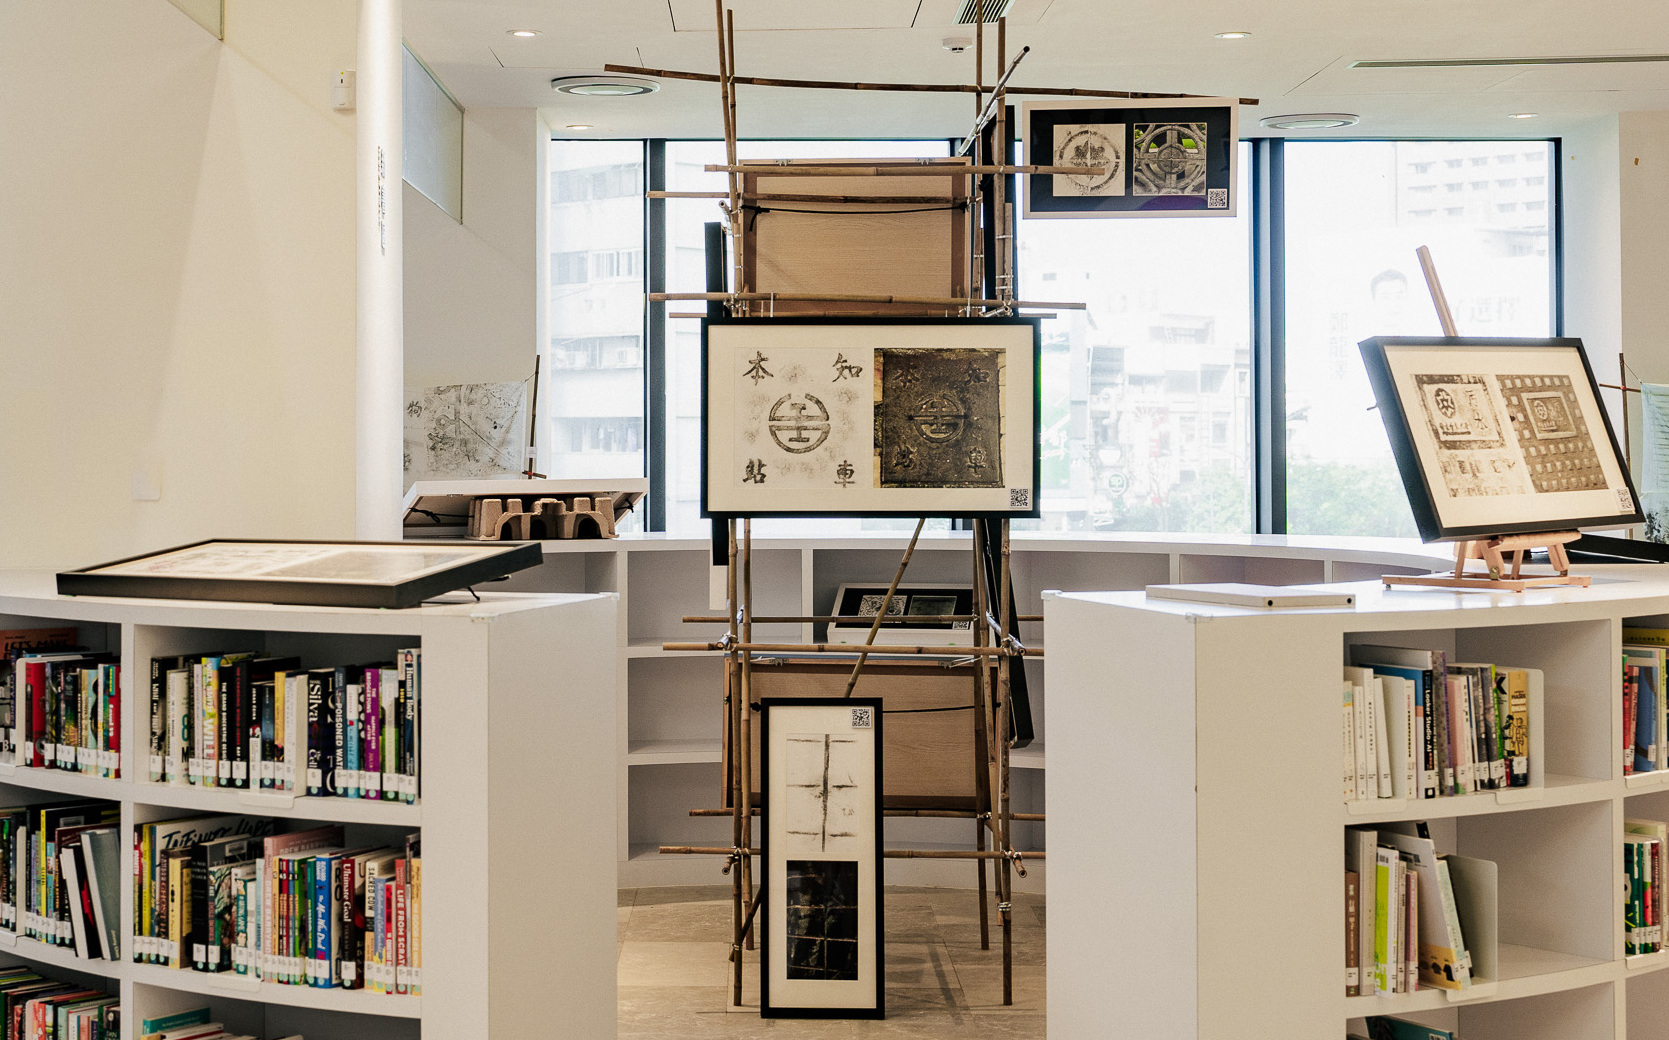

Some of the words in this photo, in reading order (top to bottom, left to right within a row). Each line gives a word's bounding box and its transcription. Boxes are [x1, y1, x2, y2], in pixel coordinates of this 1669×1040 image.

[742, 350, 774, 386] 本
[832, 352, 863, 383] 知
[834, 459, 855, 488] 車
[406, 666, 414, 698] Human
[309, 684, 322, 722] Silva
[406, 699, 415, 720] Body
[343, 863, 352, 900] Ultimate
[344, 901, 352, 922] Goal
